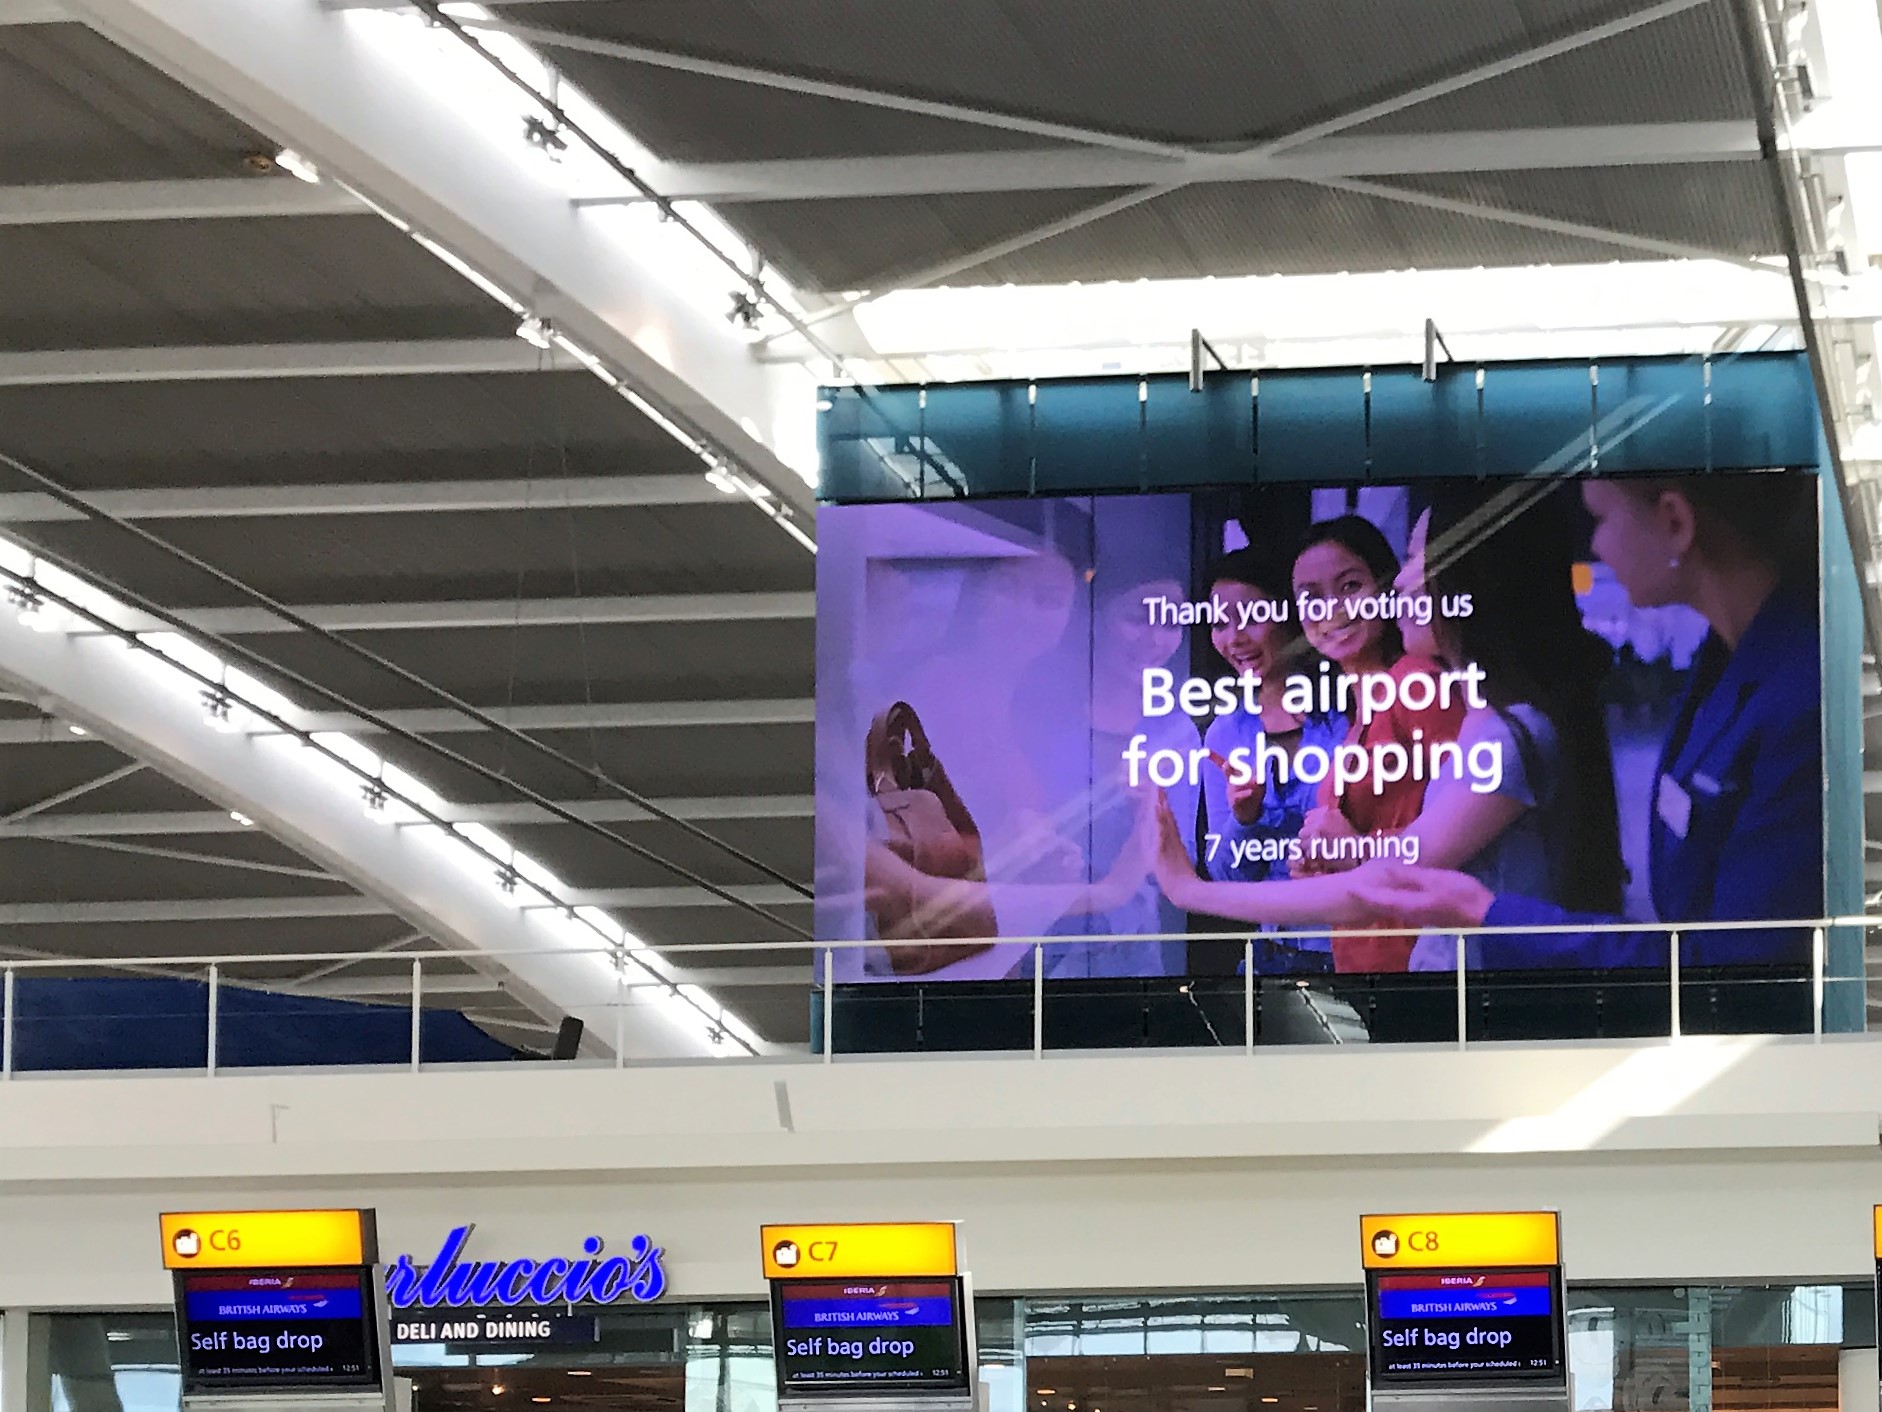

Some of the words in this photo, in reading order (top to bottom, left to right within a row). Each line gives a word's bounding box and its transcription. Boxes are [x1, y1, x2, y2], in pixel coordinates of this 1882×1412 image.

[1143, 595, 1229, 626] Thank
[1236, 598, 1289, 631] you
[1296, 591, 1339, 622] for
[1344, 591, 1433, 626] voting
[1440, 592, 1473, 618] us
[1141, 666, 1263, 718] Best
[1282, 661, 1487, 725] airport
[1121, 734, 1210, 788] for
[1228, 730, 1502, 797] shopping
[1204, 833, 1221, 863] 7
[1230, 836, 1302, 869] years
[1310, 832, 1420, 864] running
[209, 1229, 241, 1251] C6
[808, 1241, 838, 1261] C7
[1408, 1231, 1439, 1251] C8
[385, 1225, 666, 1308] rluccio's
[218, 1305, 260, 1315] BRITISH
[262, 1304, 307, 1314] AIRWAYS
[814, 1312, 855, 1322] BRITISH
[856, 1311, 899, 1321] AIRWAYS
[1411, 1303, 1452, 1313] BRITISH
[1453, 1302, 1497, 1312] AIRWAYS
[191, 1331, 228, 1351] Self
[233, 1332, 270, 1354] bag
[276, 1330, 323, 1353] drop
[397, 1322, 436, 1340] DELI
[440, 1322, 479, 1339] AND
[485, 1321, 551, 1338] DINING
[1382, 1328, 1418, 1347] Self
[1424, 1328, 1460, 1350] bag
[1466, 1327, 1512, 1348] drop
[787, 1337, 823, 1356] Self
[827, 1338, 863, 1359] bag
[869, 1336, 914, 1358] drop
